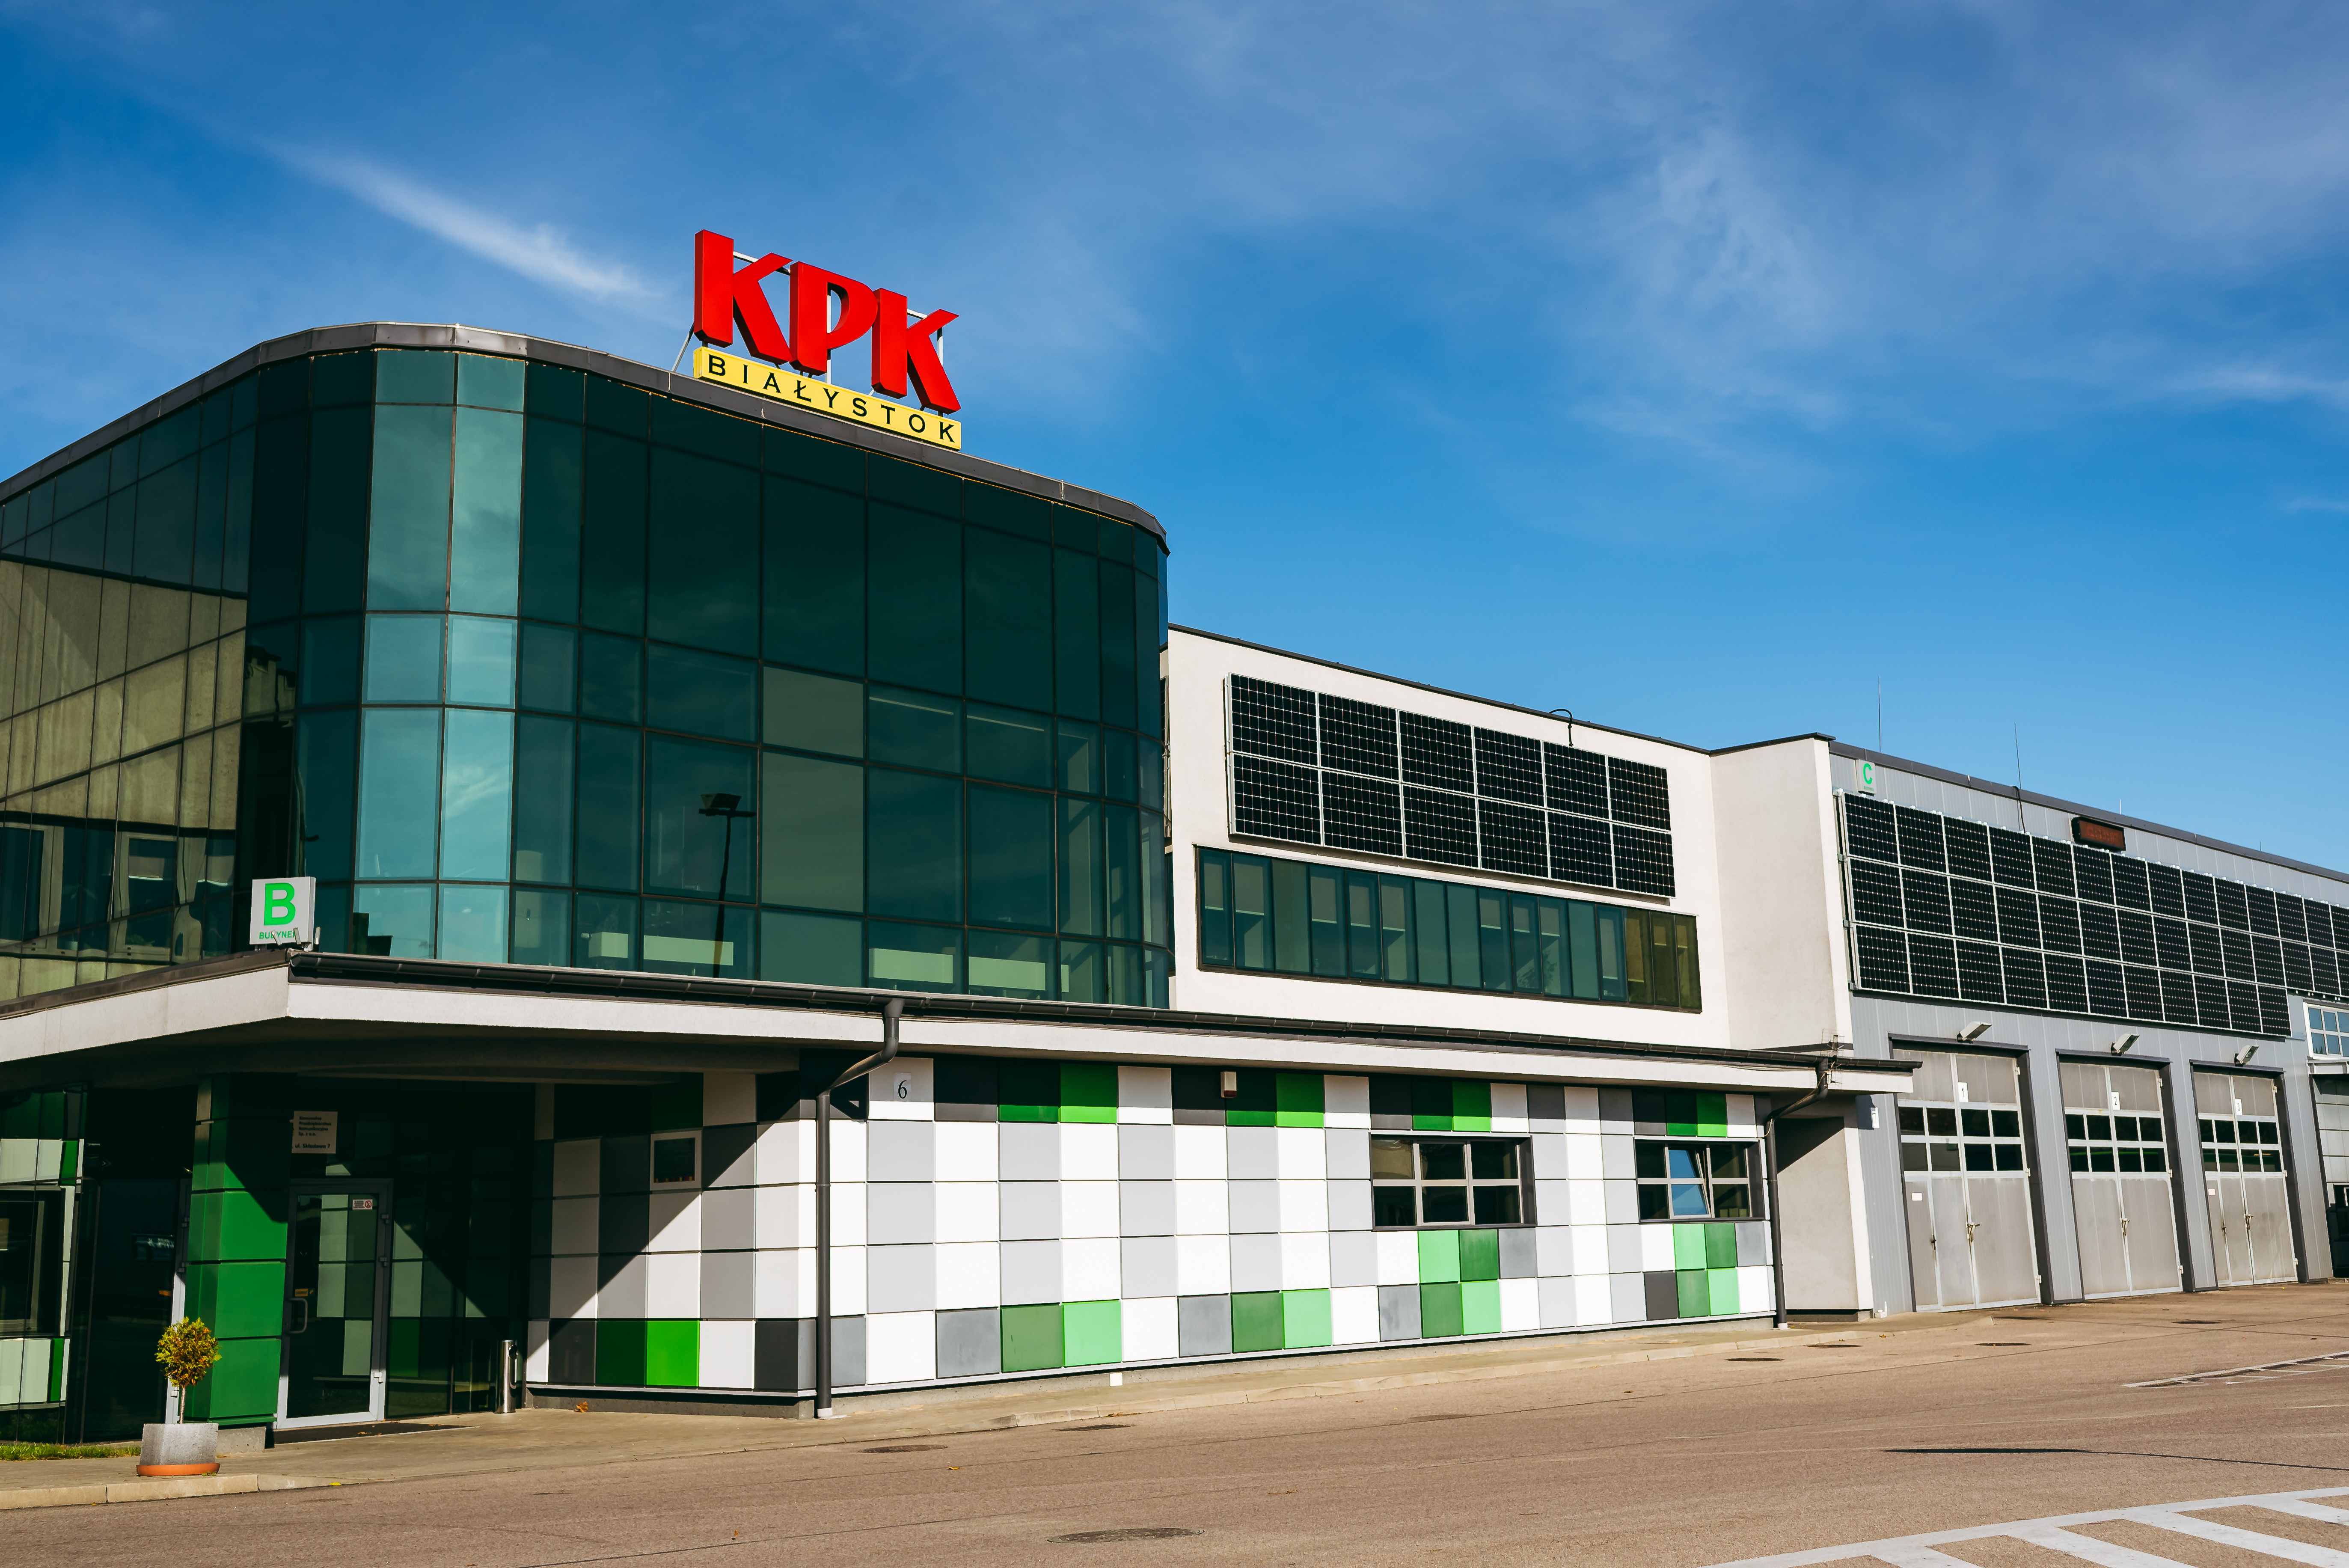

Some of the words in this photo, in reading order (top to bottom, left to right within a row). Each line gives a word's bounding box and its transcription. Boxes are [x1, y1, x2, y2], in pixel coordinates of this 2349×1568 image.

[694, 229, 961, 415] KPK
[708, 354, 955, 442] BIAŁYSTOK
[1863, 763, 1872, 784] C
[264, 882, 296, 926] B
[259, 930, 294, 939] BUYNE
[898, 1080, 907, 1099] 6
[2114, 1096, 2117, 1105] 2
